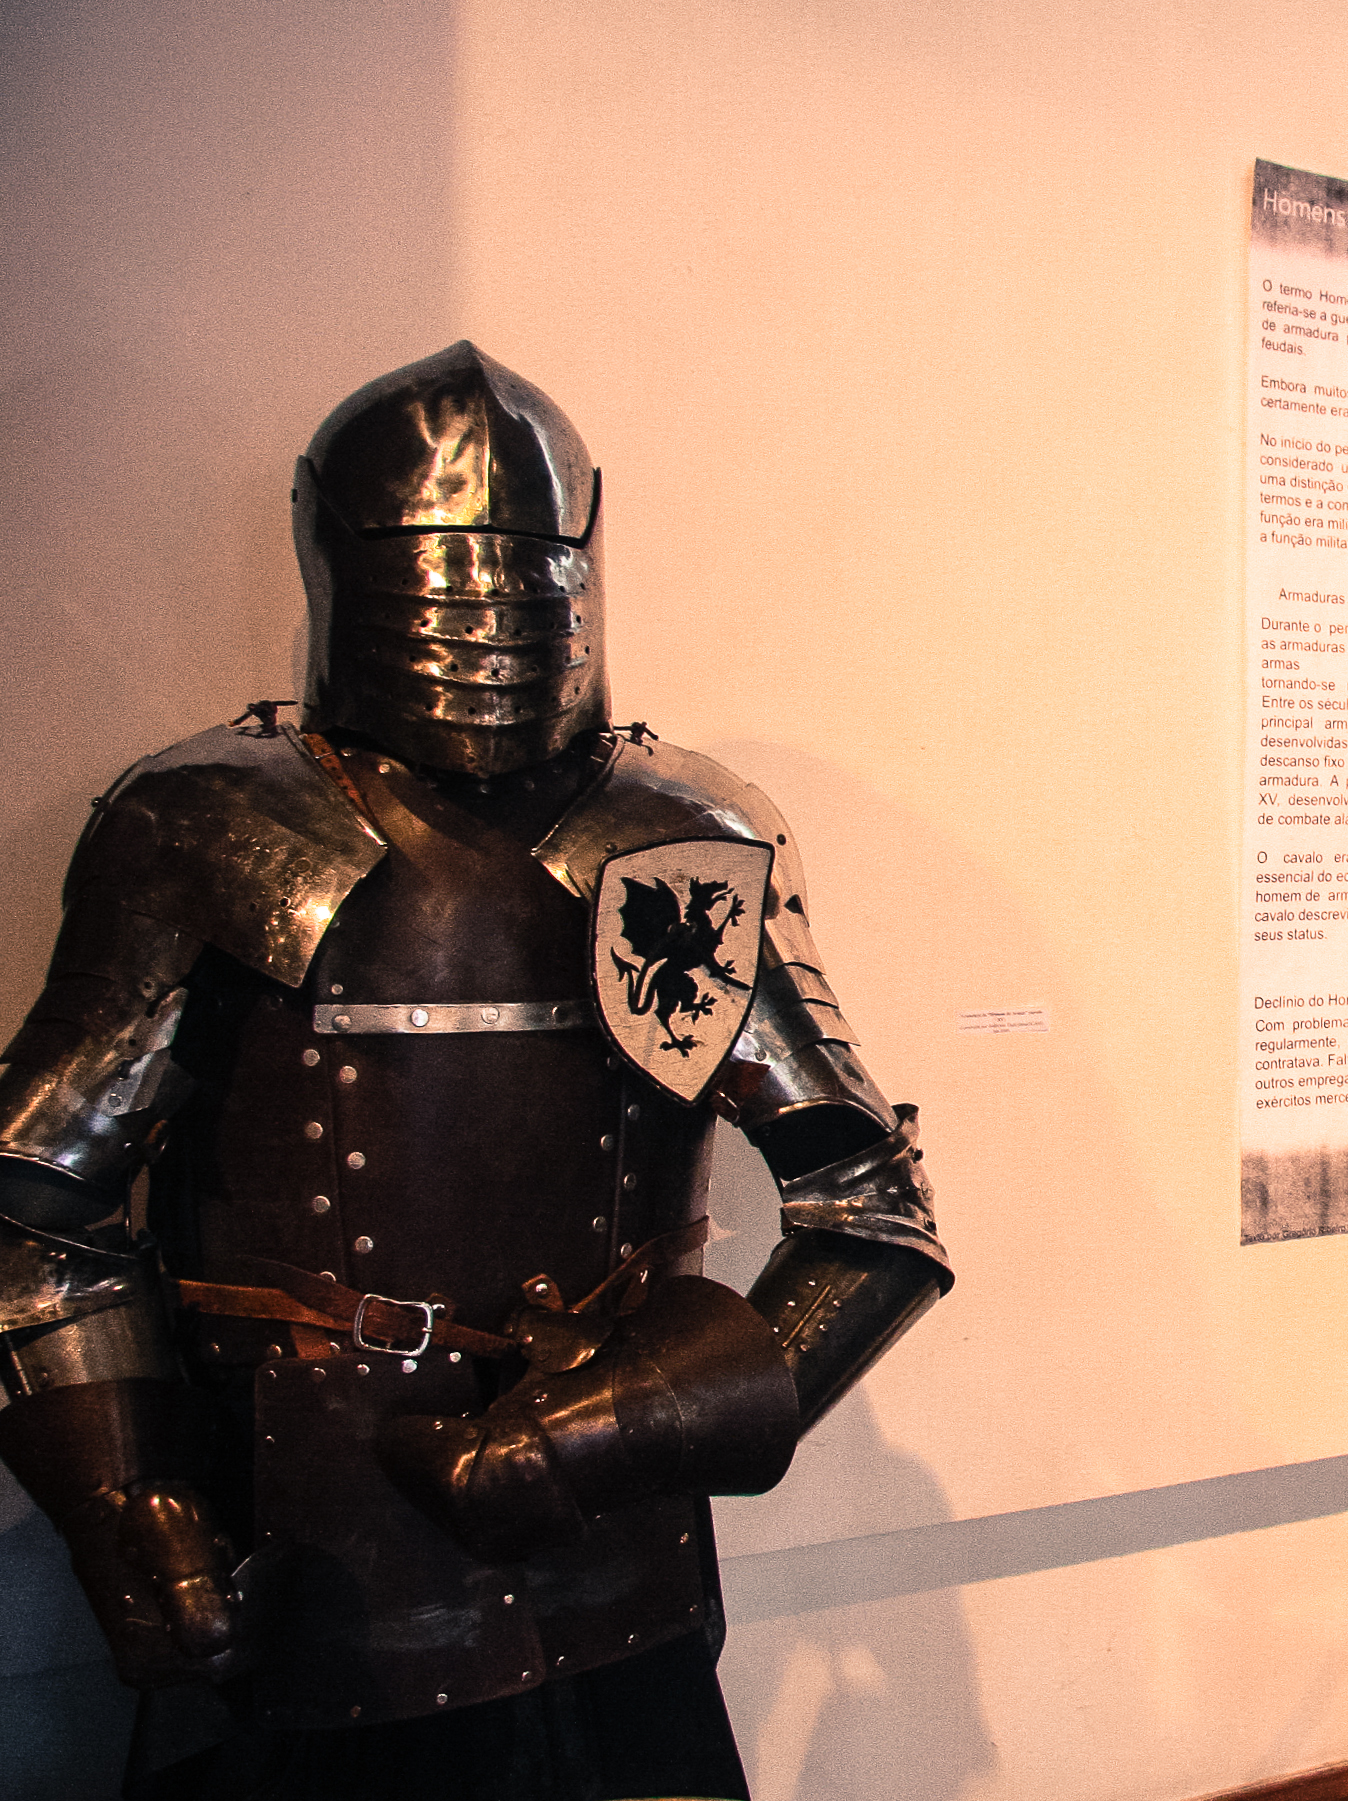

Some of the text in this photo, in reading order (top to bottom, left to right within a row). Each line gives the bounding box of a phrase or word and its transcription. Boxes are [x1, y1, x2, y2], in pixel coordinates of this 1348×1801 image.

[1263, 188, 1346, 226] Homens
[1262, 278, 1272, 292] O
[1279, 282, 1312, 300] termo
[1260, 396, 1326, 415] certamente
[1259, 532, 1267, 542] a
[1270, 530, 1312, 548] função
[1278, 587, 1345, 604] Armaduras
[1261, 616, 1310, 632] Durante
[1313, 622, 1321, 633] o
[1260, 639, 1276, 649] as
[1279, 639, 1345, 653] armaduras
[1260, 658, 1300, 670] armas
[1261, 676, 1335, 691] tornando-se
[1261, 694, 1295, 709] Entre
[1298, 699, 1314, 709] os
[1260, 716, 1313, 731] principal
[1260, 734, 1348, 748] desenvolvidas
[1259, 753, 1320, 767] descanso
[1323, 754, 1345, 767] fixo
[1329, 774, 1339, 786] A
[1258, 792, 1280, 806] XV,
[1257, 812, 1274, 825] de
[1277, 812, 1330, 825] combate
[1256, 850, 1268, 864] O
[1282, 850, 1323, 863] cavalo
[1255, 870, 1314, 883] essencial
[1316, 869, 1332, 882] do
[1255, 890, 1301, 902] homem
[1304, 889, 1320, 901] de
[1254, 908, 1295, 922] cavalo
[1254, 930, 1283, 941] seus
[1308, 994, 1324, 1007] do
